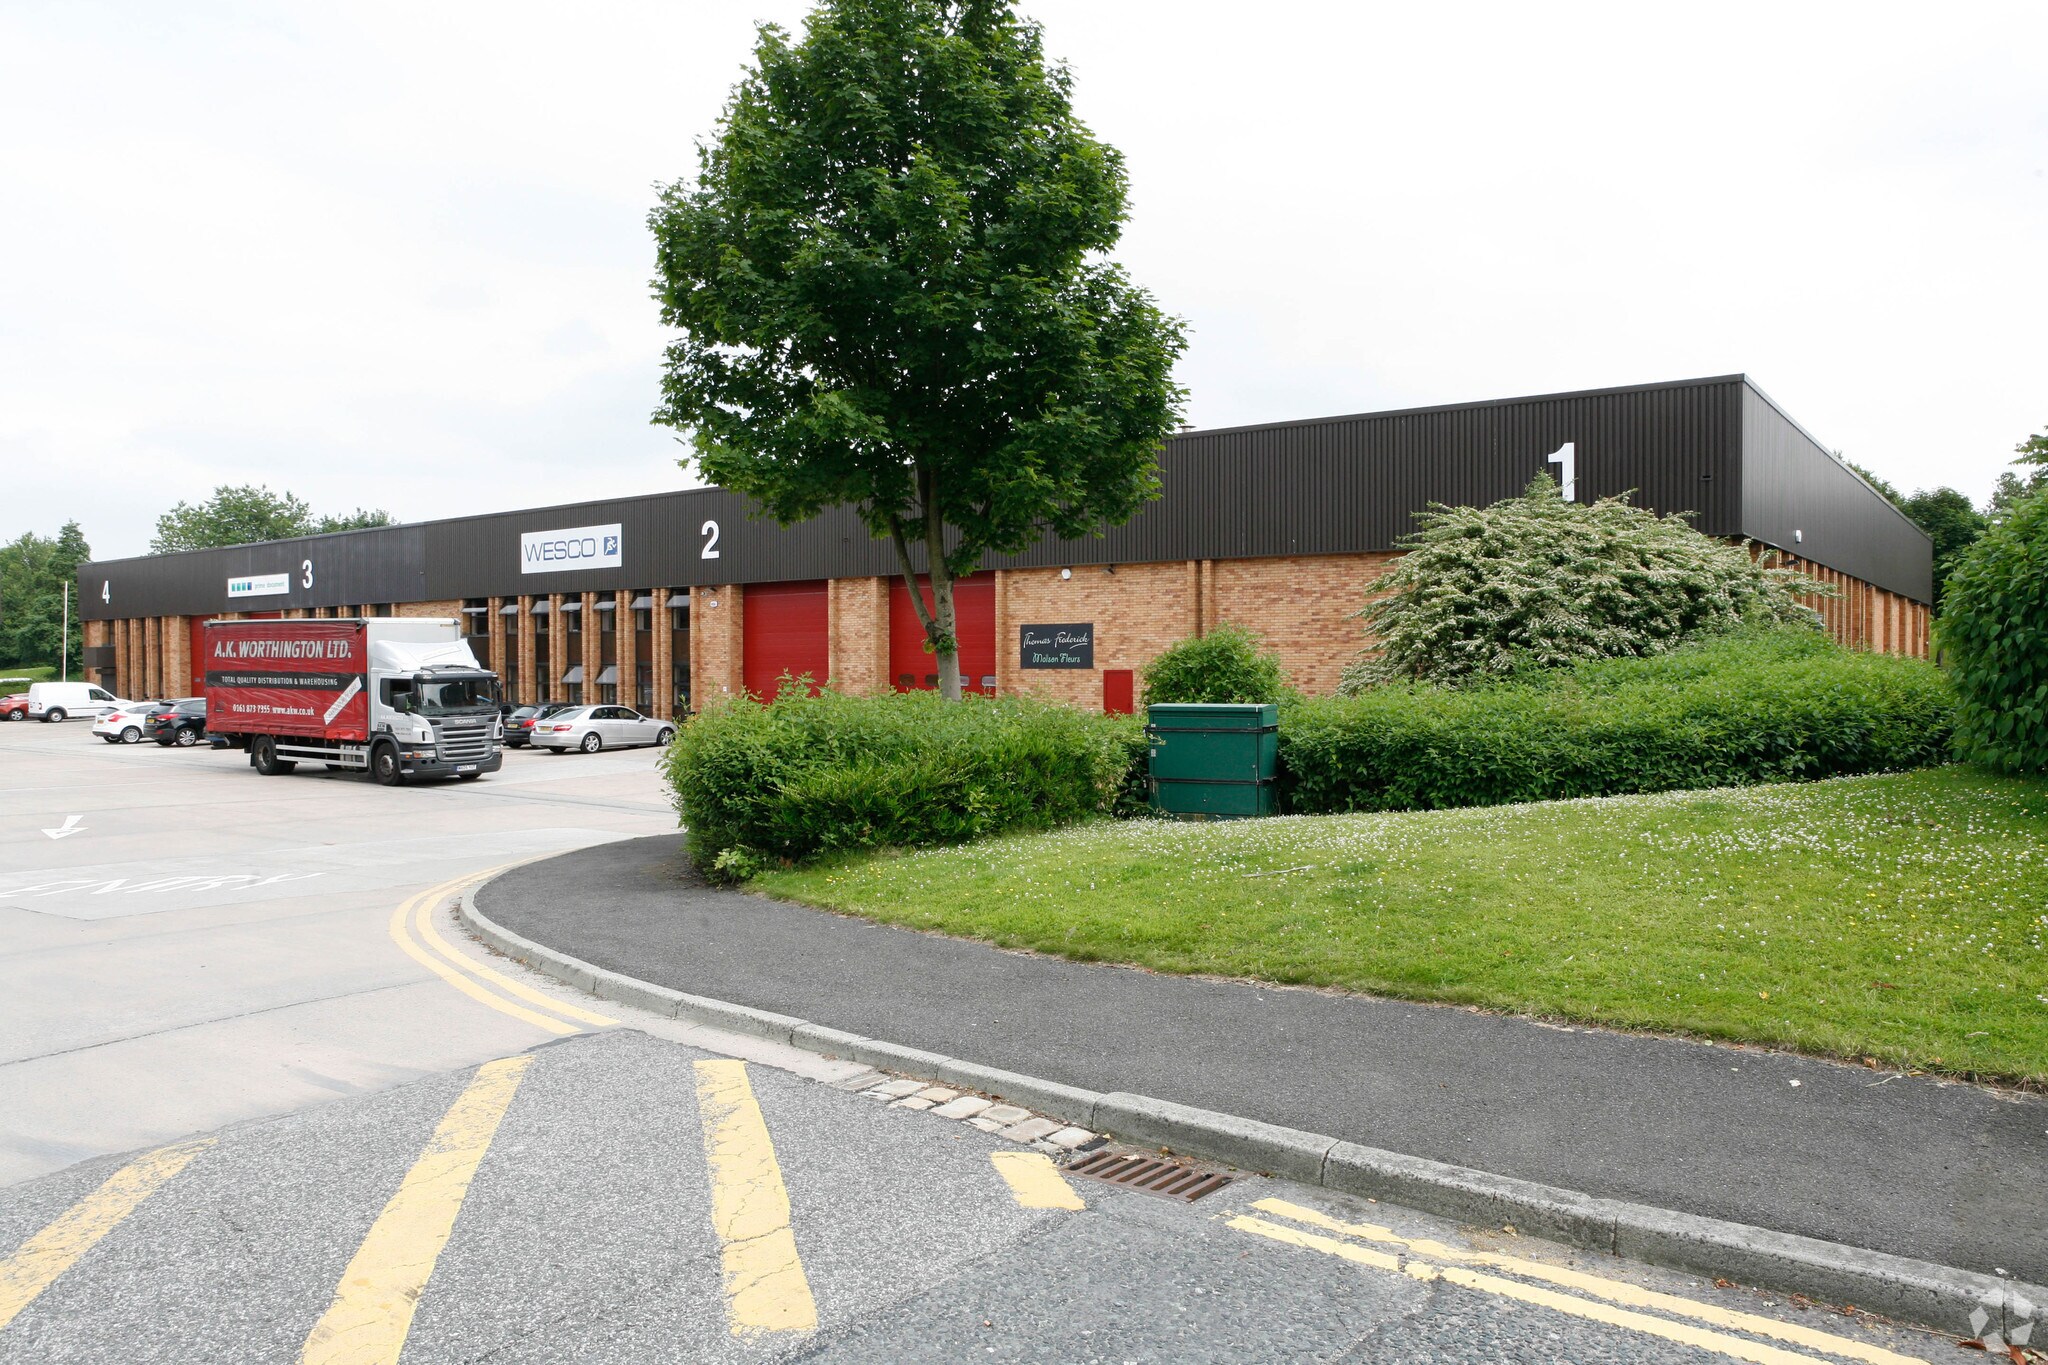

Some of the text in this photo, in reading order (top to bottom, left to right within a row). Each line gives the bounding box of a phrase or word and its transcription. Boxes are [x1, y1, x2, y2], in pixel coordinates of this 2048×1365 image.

[1548, 442, 1575, 501] 1
[524, 538, 596, 562] WESCO
[701, 520, 720, 560] 2
[302, 559, 314, 589] 3
[102, 580, 111, 604] 4
[214, 640, 352, 658] A.K. WORTHINGTON LTD.
[1023, 631, 1090, 648] Thomas Frederick
[1059, 653, 1081, 663] Fleurs
[237, 676, 257, 684] QUALITY
[257, 677, 293, 685] DISTRIBUTION
[299, 678, 338, 686] WAREHOUSING
[232, 703, 315, 716] 0161 873 7355 www.akw.co.uk
